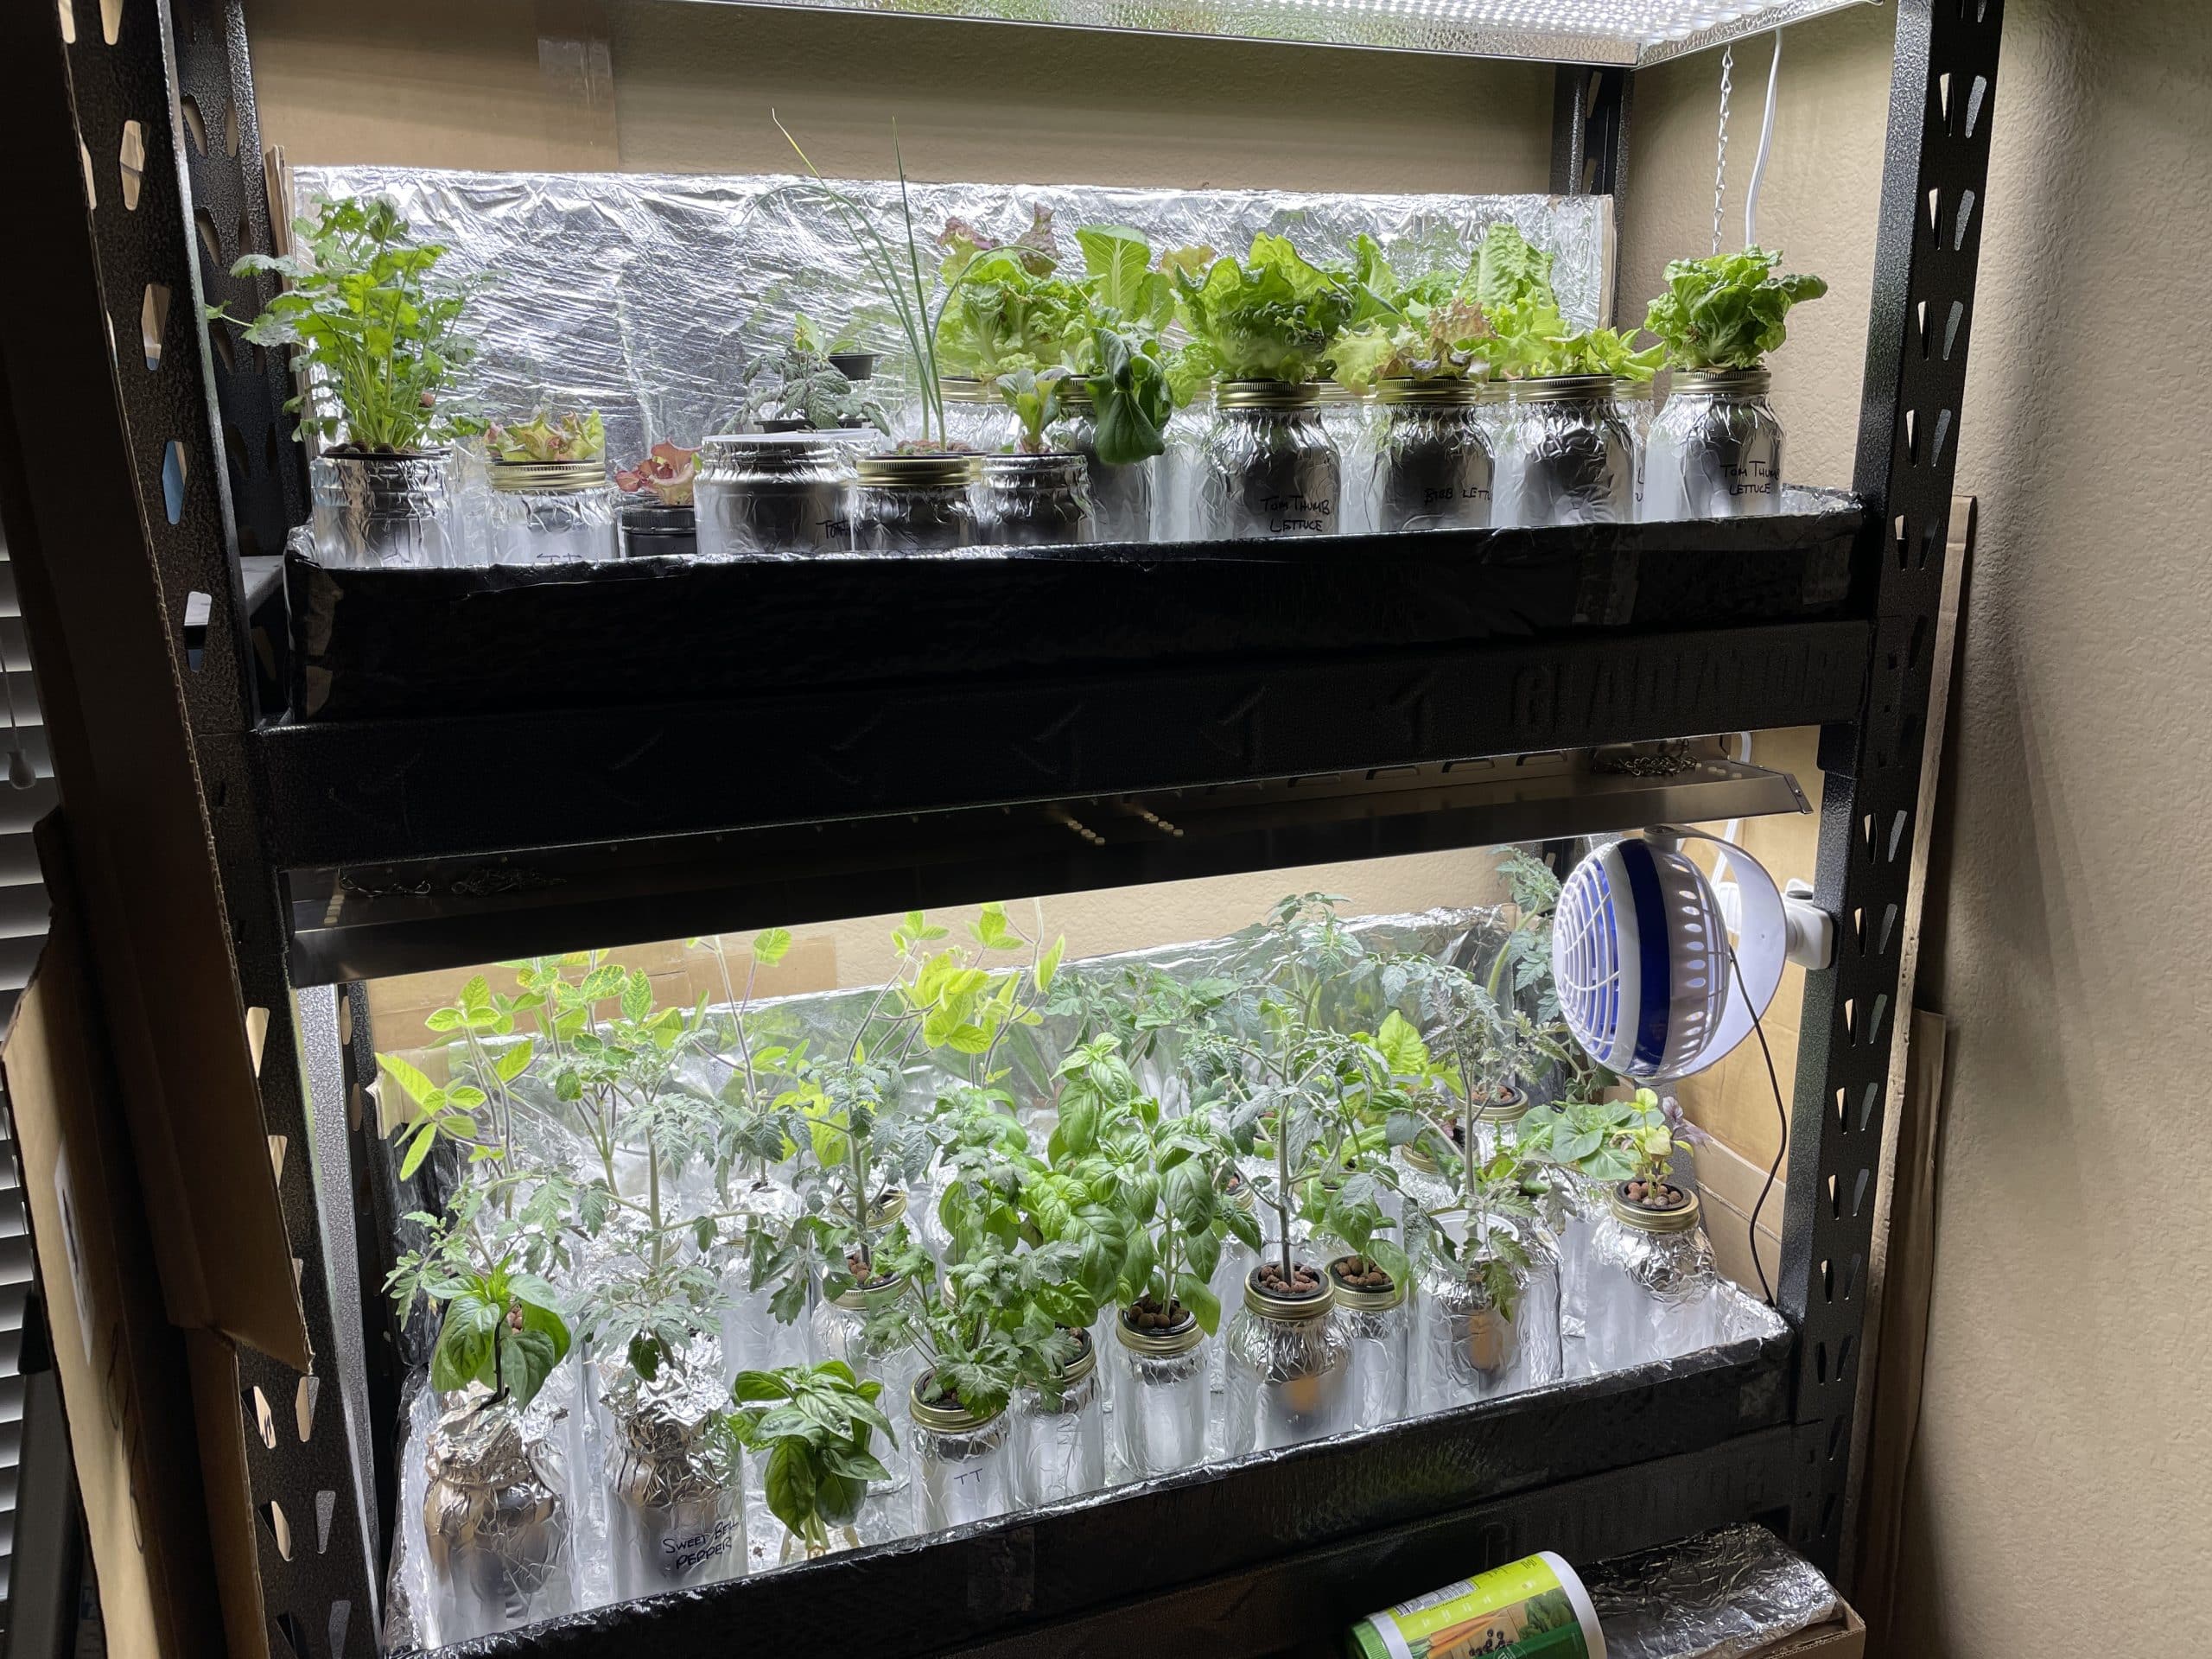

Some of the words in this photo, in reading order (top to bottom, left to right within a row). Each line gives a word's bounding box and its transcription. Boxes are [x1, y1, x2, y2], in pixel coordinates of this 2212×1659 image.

[1719, 464, 1747, 477] TOM
[1730, 483, 1771, 495] LETTUCE
[1289, 496, 1330, 515] THUMB
[1269, 518, 1323, 532] LETTUCE
[953, 1467, 983, 1485] TT
[663, 1534, 709, 1553] SWEET
[715, 1517, 739, 1539] BELL
[676, 1536, 732, 1569] PEPPER
